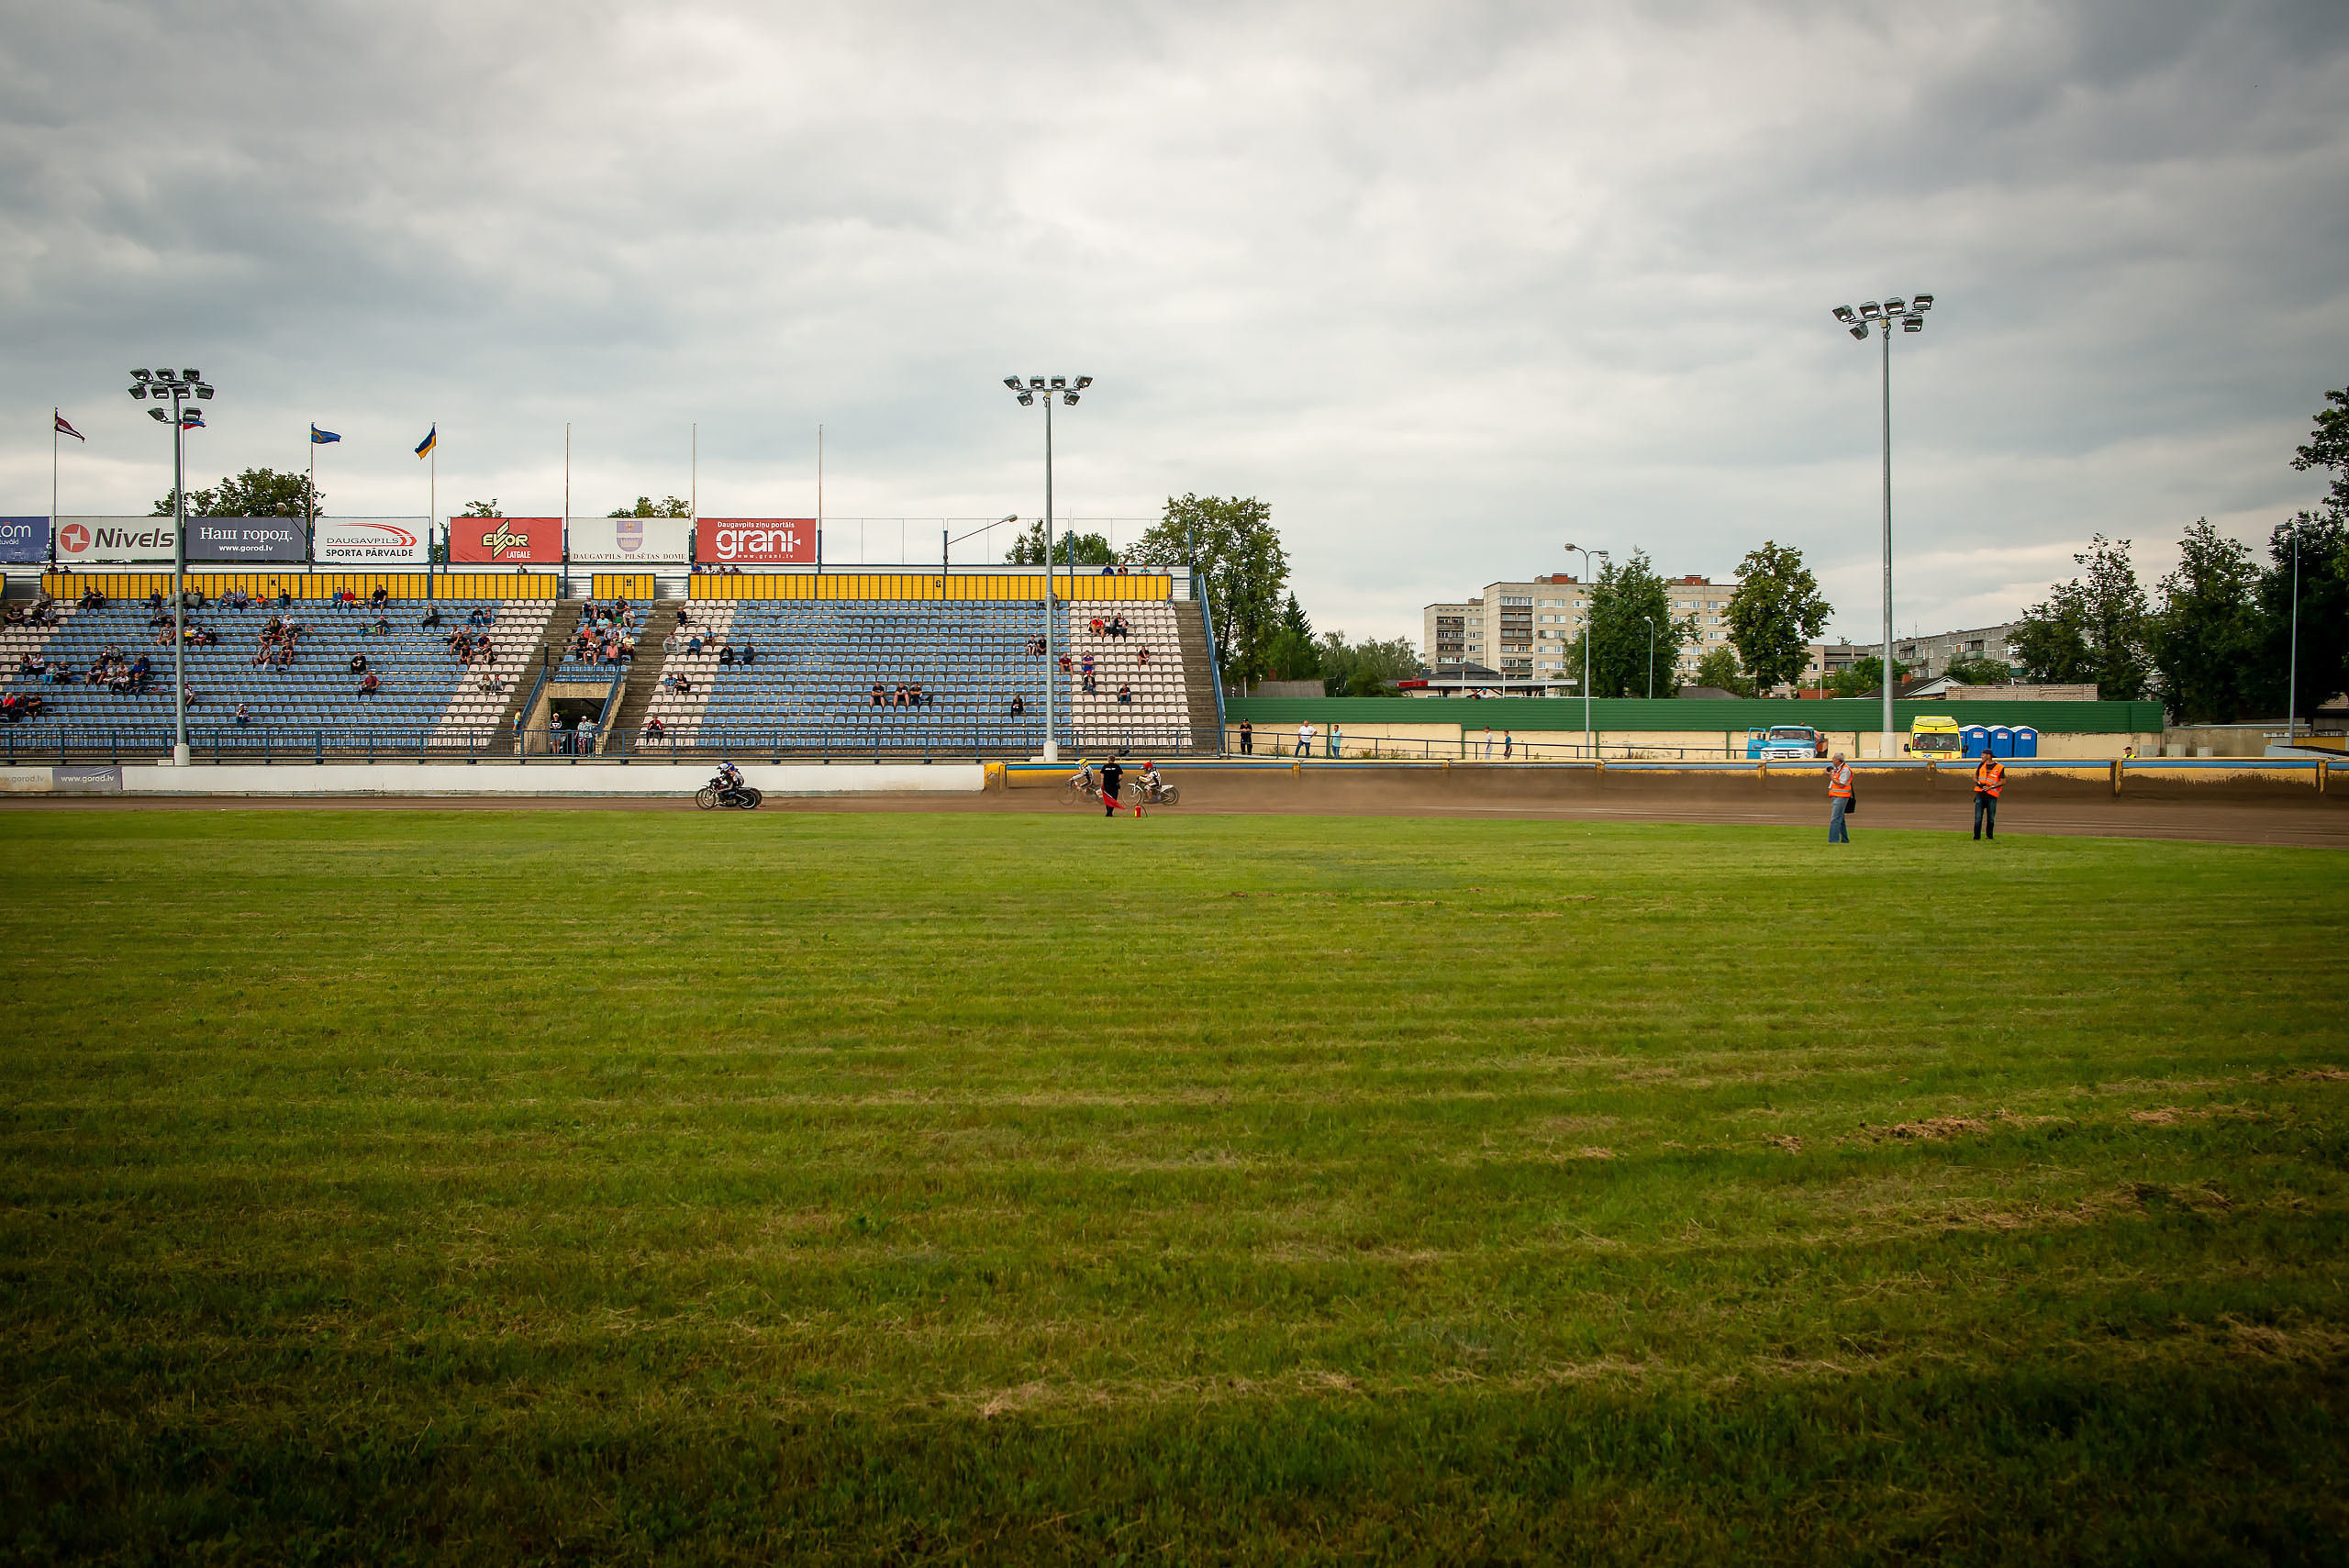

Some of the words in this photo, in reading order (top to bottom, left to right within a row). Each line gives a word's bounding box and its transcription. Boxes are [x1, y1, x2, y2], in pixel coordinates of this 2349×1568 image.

[755, 521, 770, 529] ziņu
[0, 525, 31, 538] om
[199, 527, 238, 540] Наш
[242, 529, 294, 543] город.
[95, 528, 175, 548] Nivels
[218, 544, 273, 552] www.gorod.lv
[716, 529, 794, 560] grani
[326, 549, 362, 557] SPORTA
[365, 547, 414, 557] PĀRVALDE
[507, 550, 531, 559] LATGALE
[61, 774, 115, 784] www.gorod.lv
